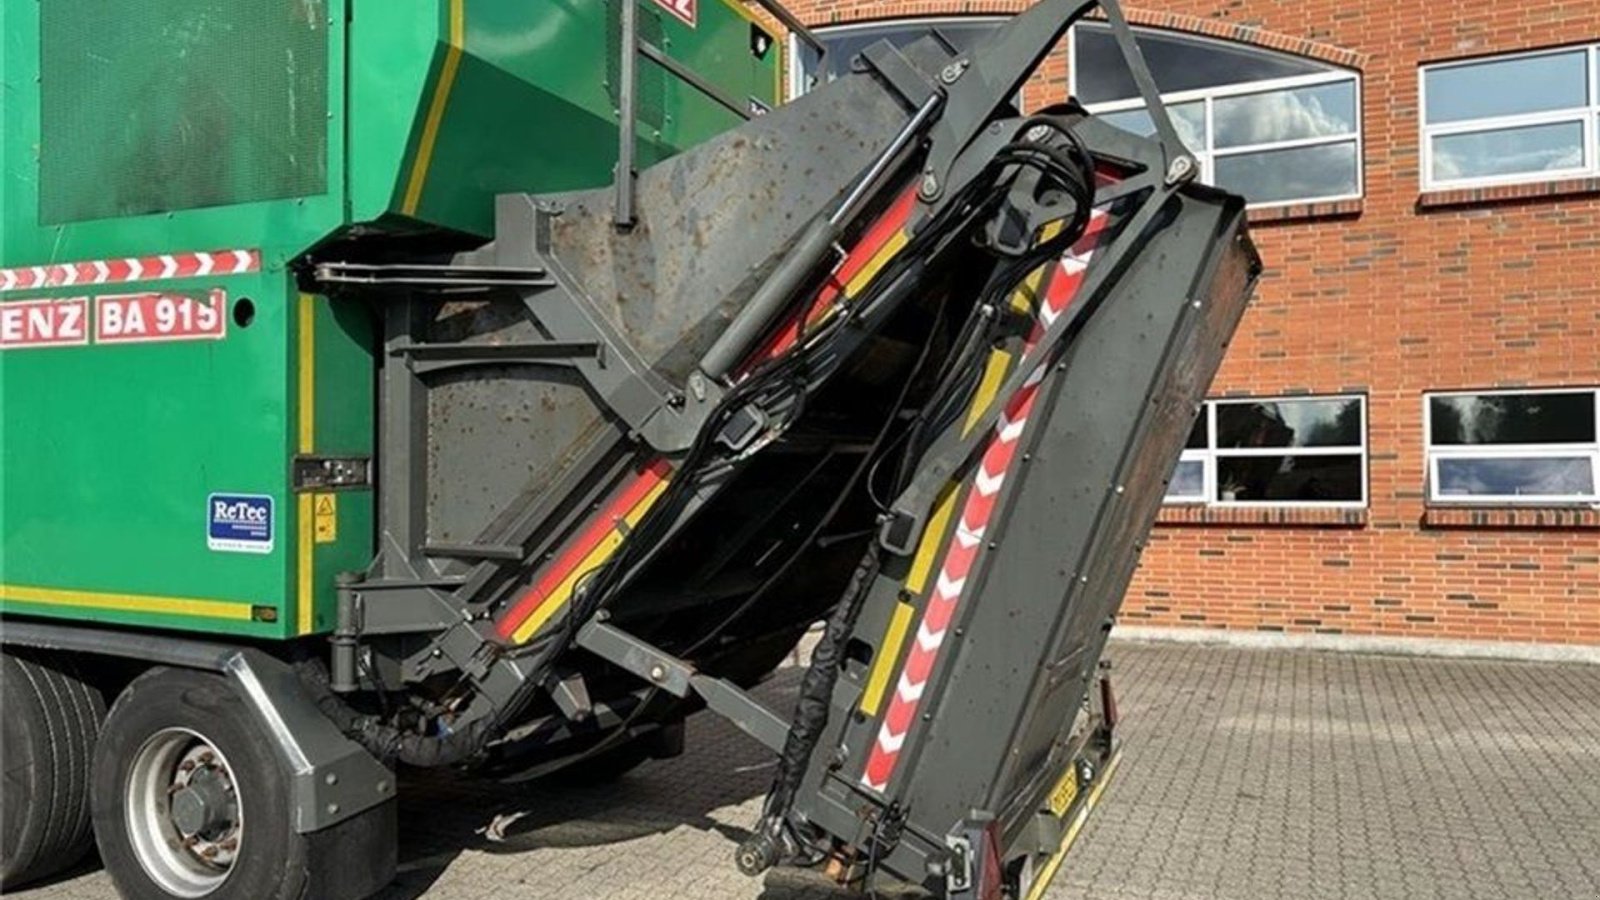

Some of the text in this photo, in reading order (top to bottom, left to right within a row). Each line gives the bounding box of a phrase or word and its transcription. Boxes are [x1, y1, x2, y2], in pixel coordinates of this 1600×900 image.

[2, 304, 82, 340] ENZ
[102, 296, 218, 335] BA 915
[214, 500, 267, 520] ReTec
